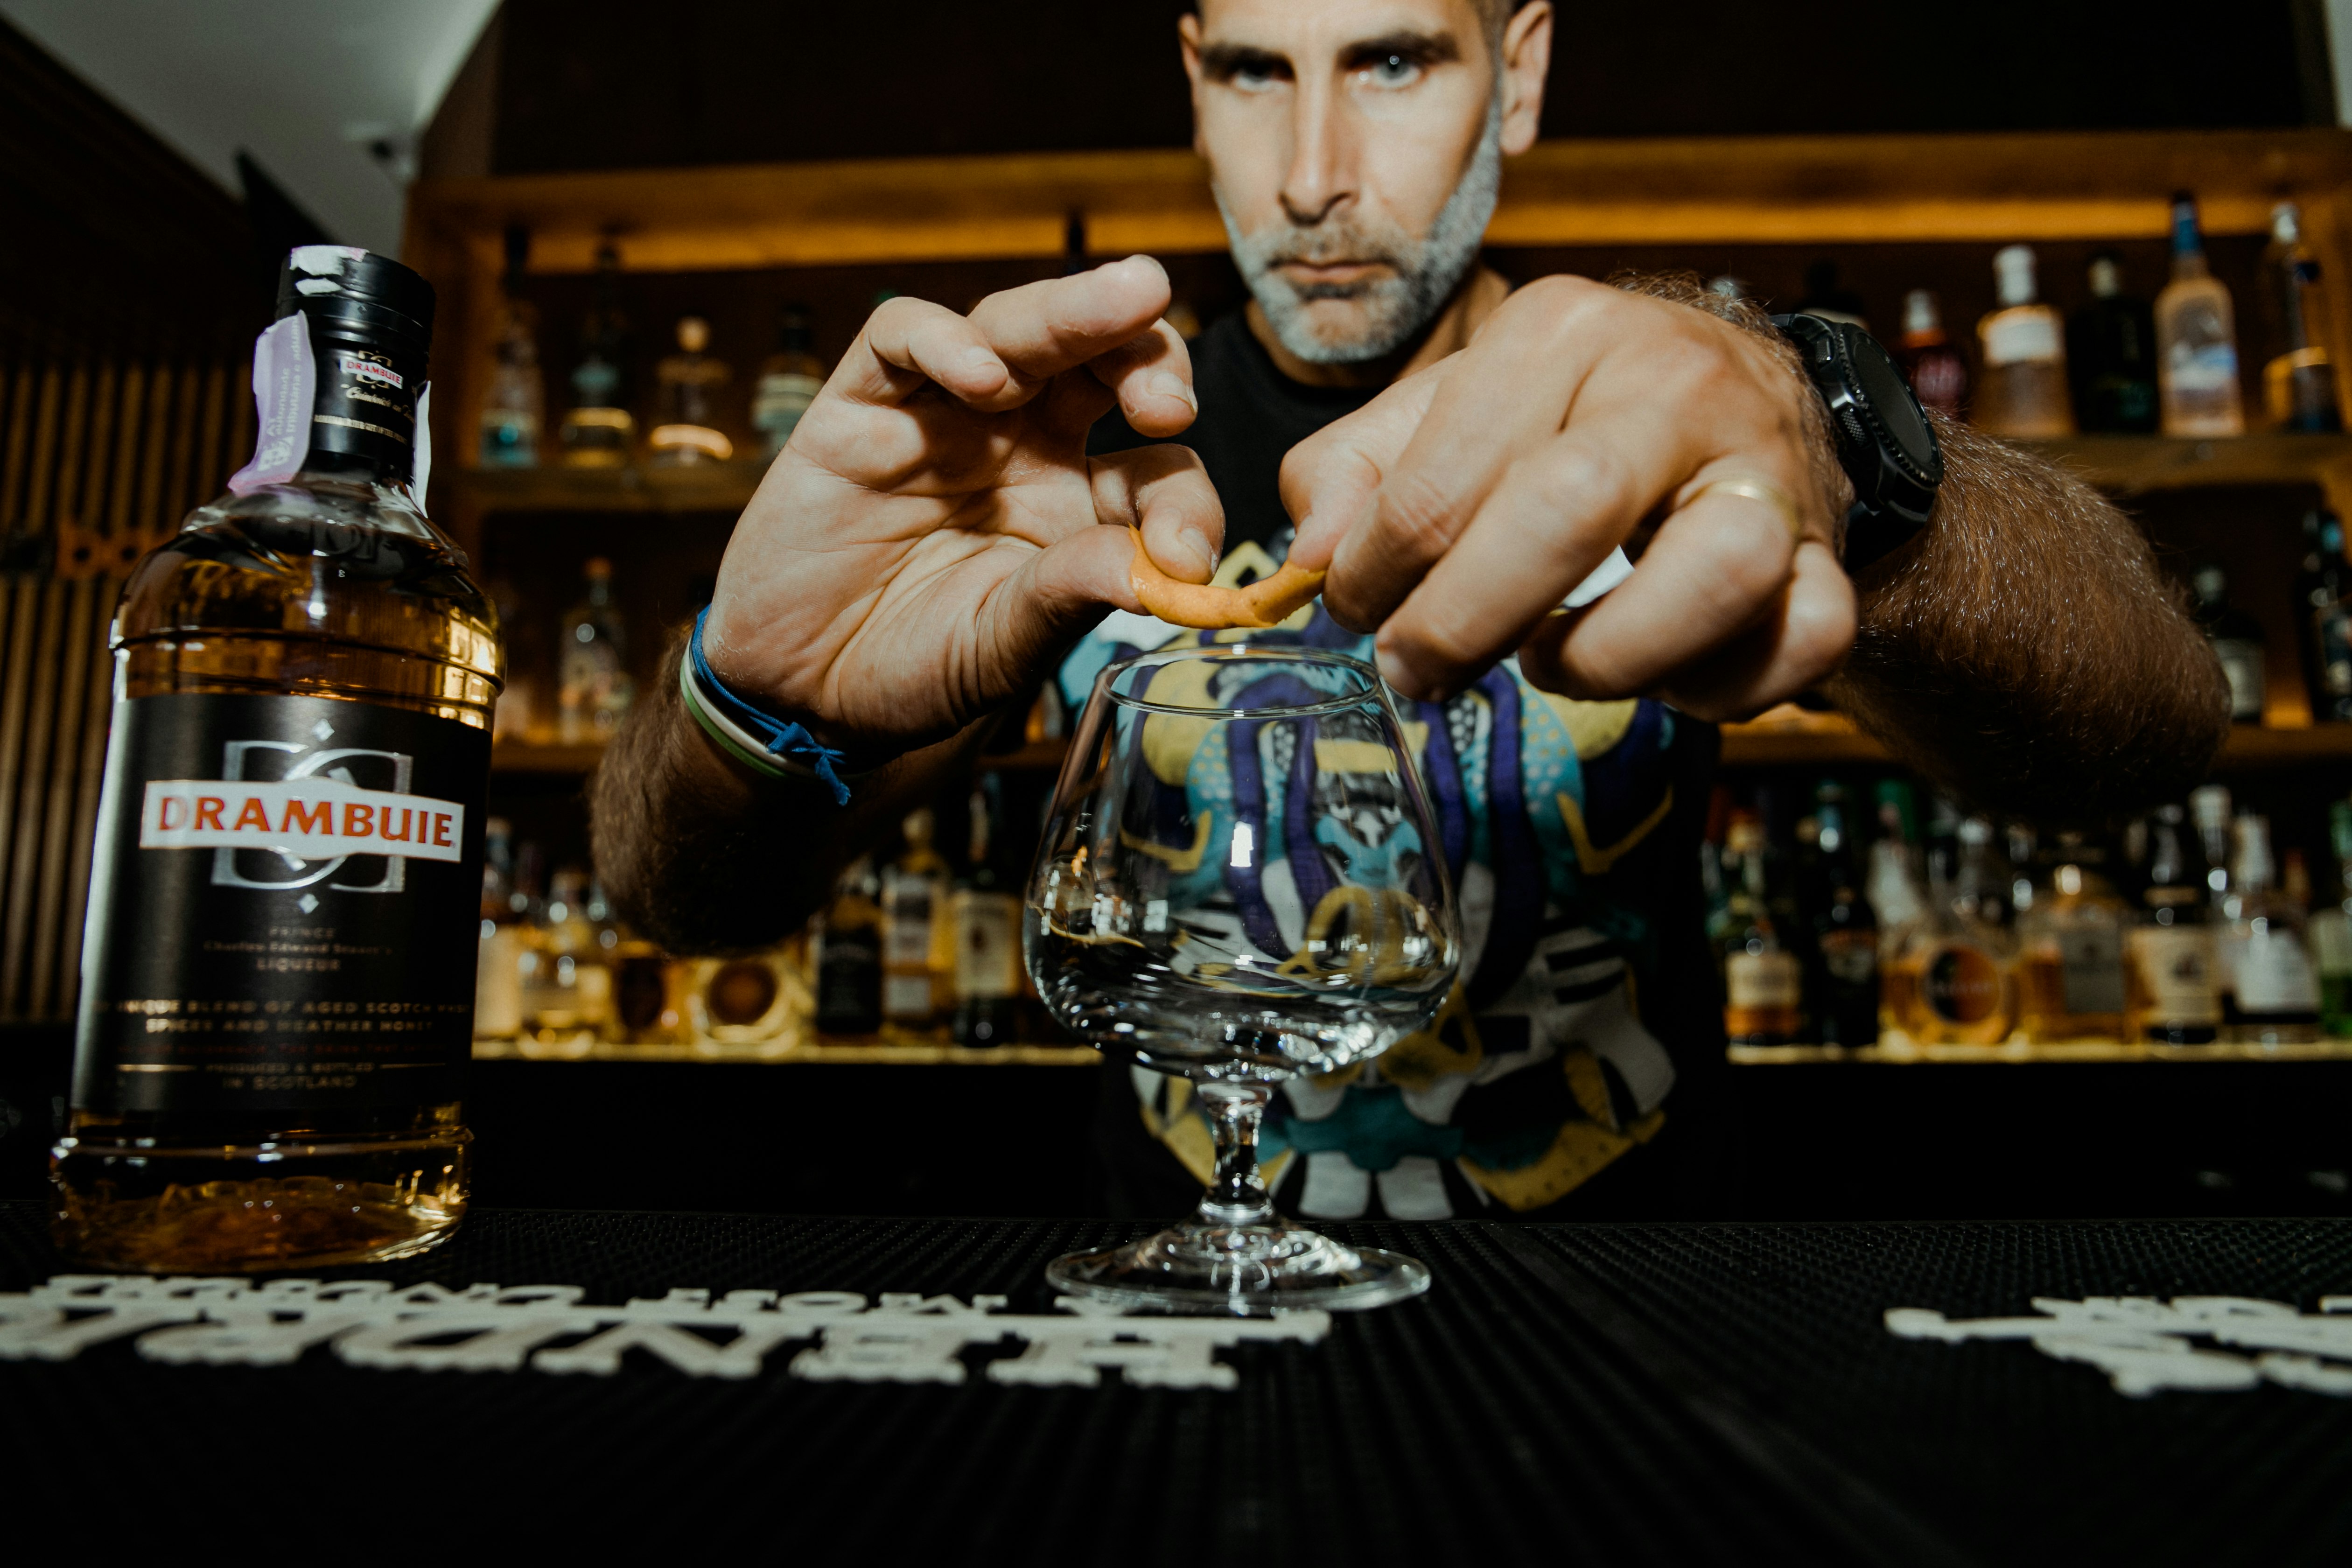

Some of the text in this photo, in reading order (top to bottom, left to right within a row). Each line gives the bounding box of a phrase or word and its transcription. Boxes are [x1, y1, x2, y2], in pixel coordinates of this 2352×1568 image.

[347, 361, 400, 384] DRAMBUIE
[158, 796, 454, 847] DRAMBUIE
[268, 926, 336, 940] PRINCE
[256, 957, 342, 972] LIQUEUR
[187, 1000, 258, 1014] BLEND
[264, 1000, 296, 1014] OF
[302, 1001, 358, 1014] AGED
[366, 1002, 431, 1014] SCOTCH
[146, 1018, 433, 1033] SPICES AND HEATHER HONEY
[205, 1062, 290, 1074] PRODUCED
[311, 1062, 375, 1074] BOTTLED
[223, 1074, 357, 1090] IN SCOTLAND
